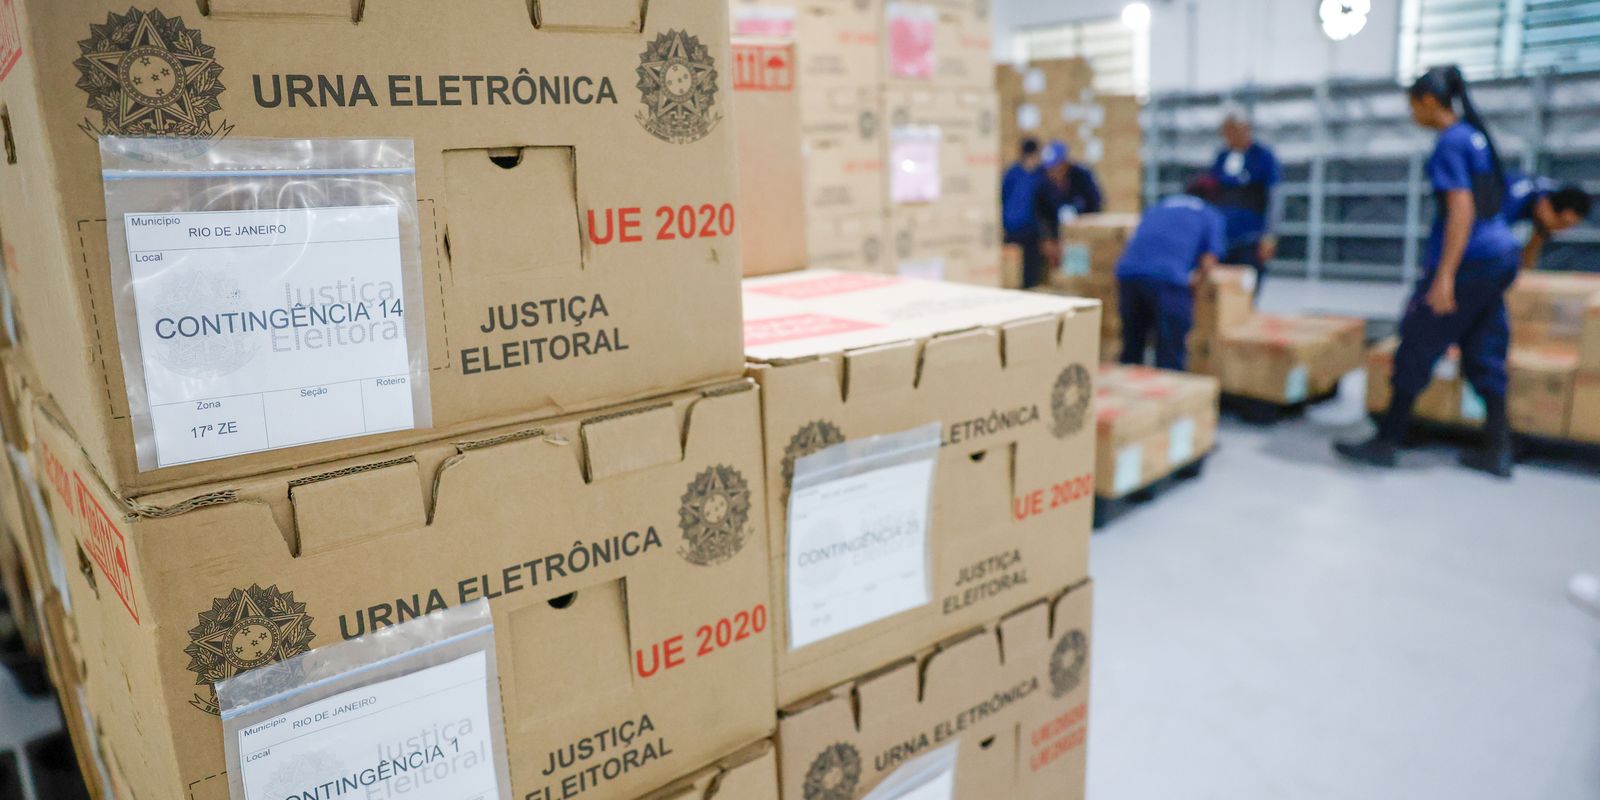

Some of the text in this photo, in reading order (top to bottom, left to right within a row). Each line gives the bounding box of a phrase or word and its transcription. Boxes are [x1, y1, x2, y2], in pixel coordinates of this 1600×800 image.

[252, 68, 618, 108] URNA ELETRÔNICA
[131, 215, 181, 227] Município
[188, 224, 287, 237] RIO DE JANEIRO
[587, 203, 735, 245] UE 2020
[135, 253, 163, 263] Local
[284, 276, 394, 314] Justiça
[480, 293, 609, 333] JUSTIÇA
[155, 298, 403, 340] CONTINGÊNCIA 14
[460, 327, 629, 374] ELEITORAL
[300, 387, 328, 398] Seção
[376, 376, 406, 387] Roteiro
[196, 400, 221, 410] Zona
[190, 421, 238, 439] 17ª ZE
[940, 404, 1040, 447] LETRÔNICA
[1014, 488, 1044, 520] UE
[338, 525, 663, 641] URNA ELETRÔNICA
[954, 548, 1021, 587] JUSTIÇA
[943, 568, 1028, 616] ELEITORAL
[636, 603, 767, 679] UE 2020
[243, 717, 287, 737] Município
[292, 696, 377, 729] RIO DE JANEIRO
[874, 676, 1040, 772] URNA ELETRÔNICA
[246, 749, 271, 763] Local
[542, 713, 655, 776] JUSTIÇA
[285, 737, 460, 800] NTINGÊNCIA 1
